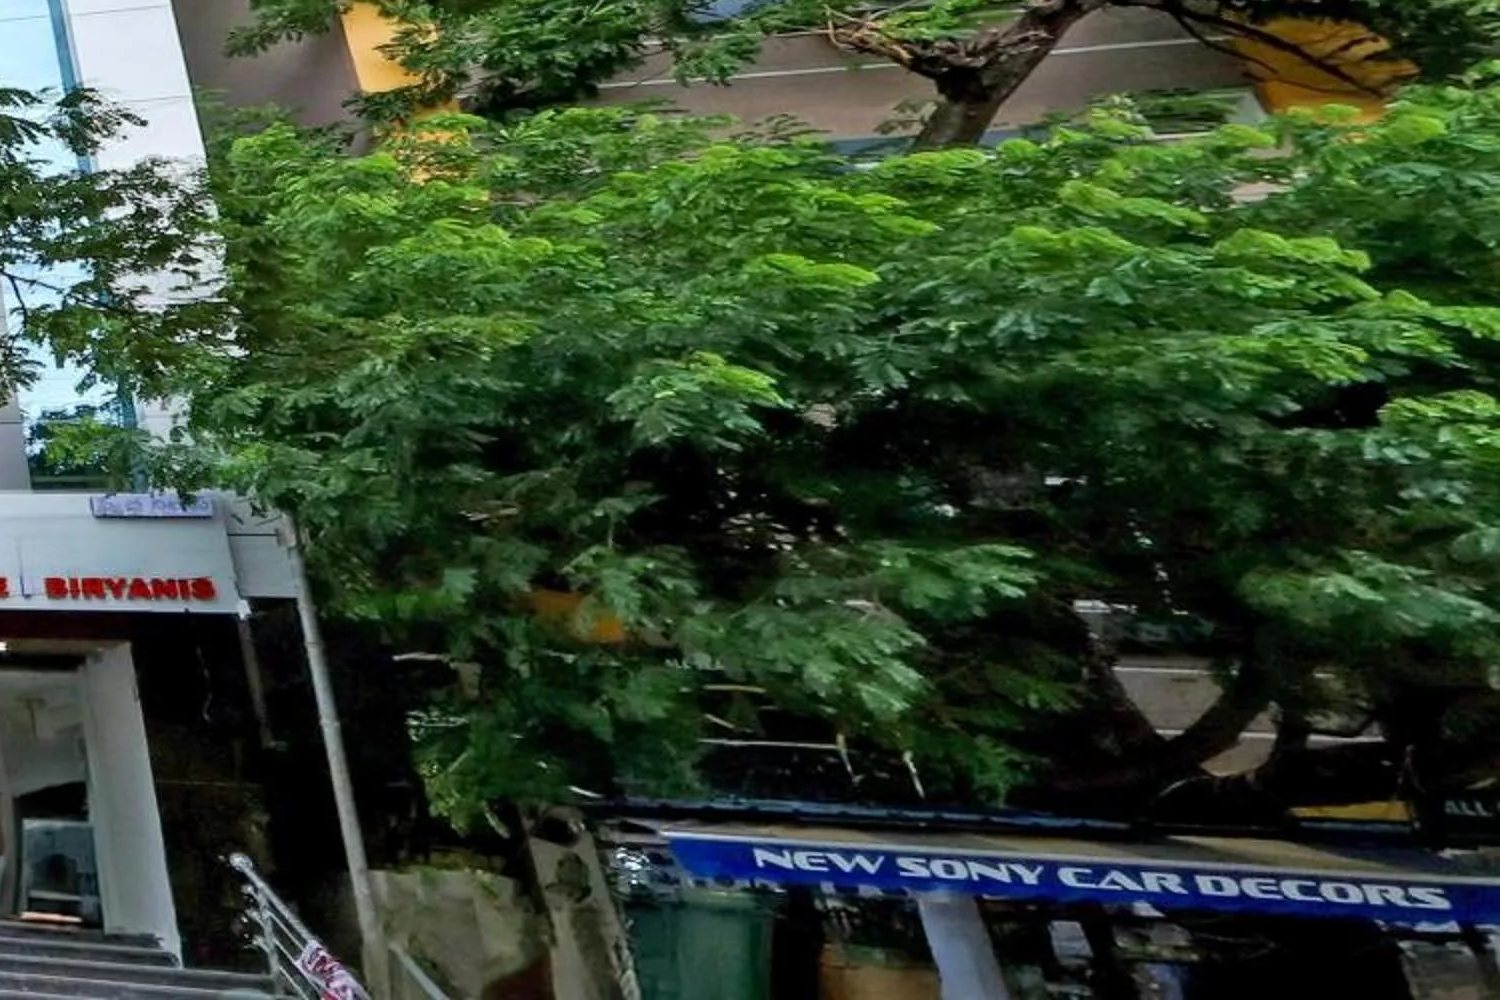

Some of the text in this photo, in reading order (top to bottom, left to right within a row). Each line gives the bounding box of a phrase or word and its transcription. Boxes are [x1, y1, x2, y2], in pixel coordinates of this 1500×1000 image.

[45, 576, 216, 601] BIRYANIS
[754, 849, 1452, 910] NEW SONY CAR DECORS
